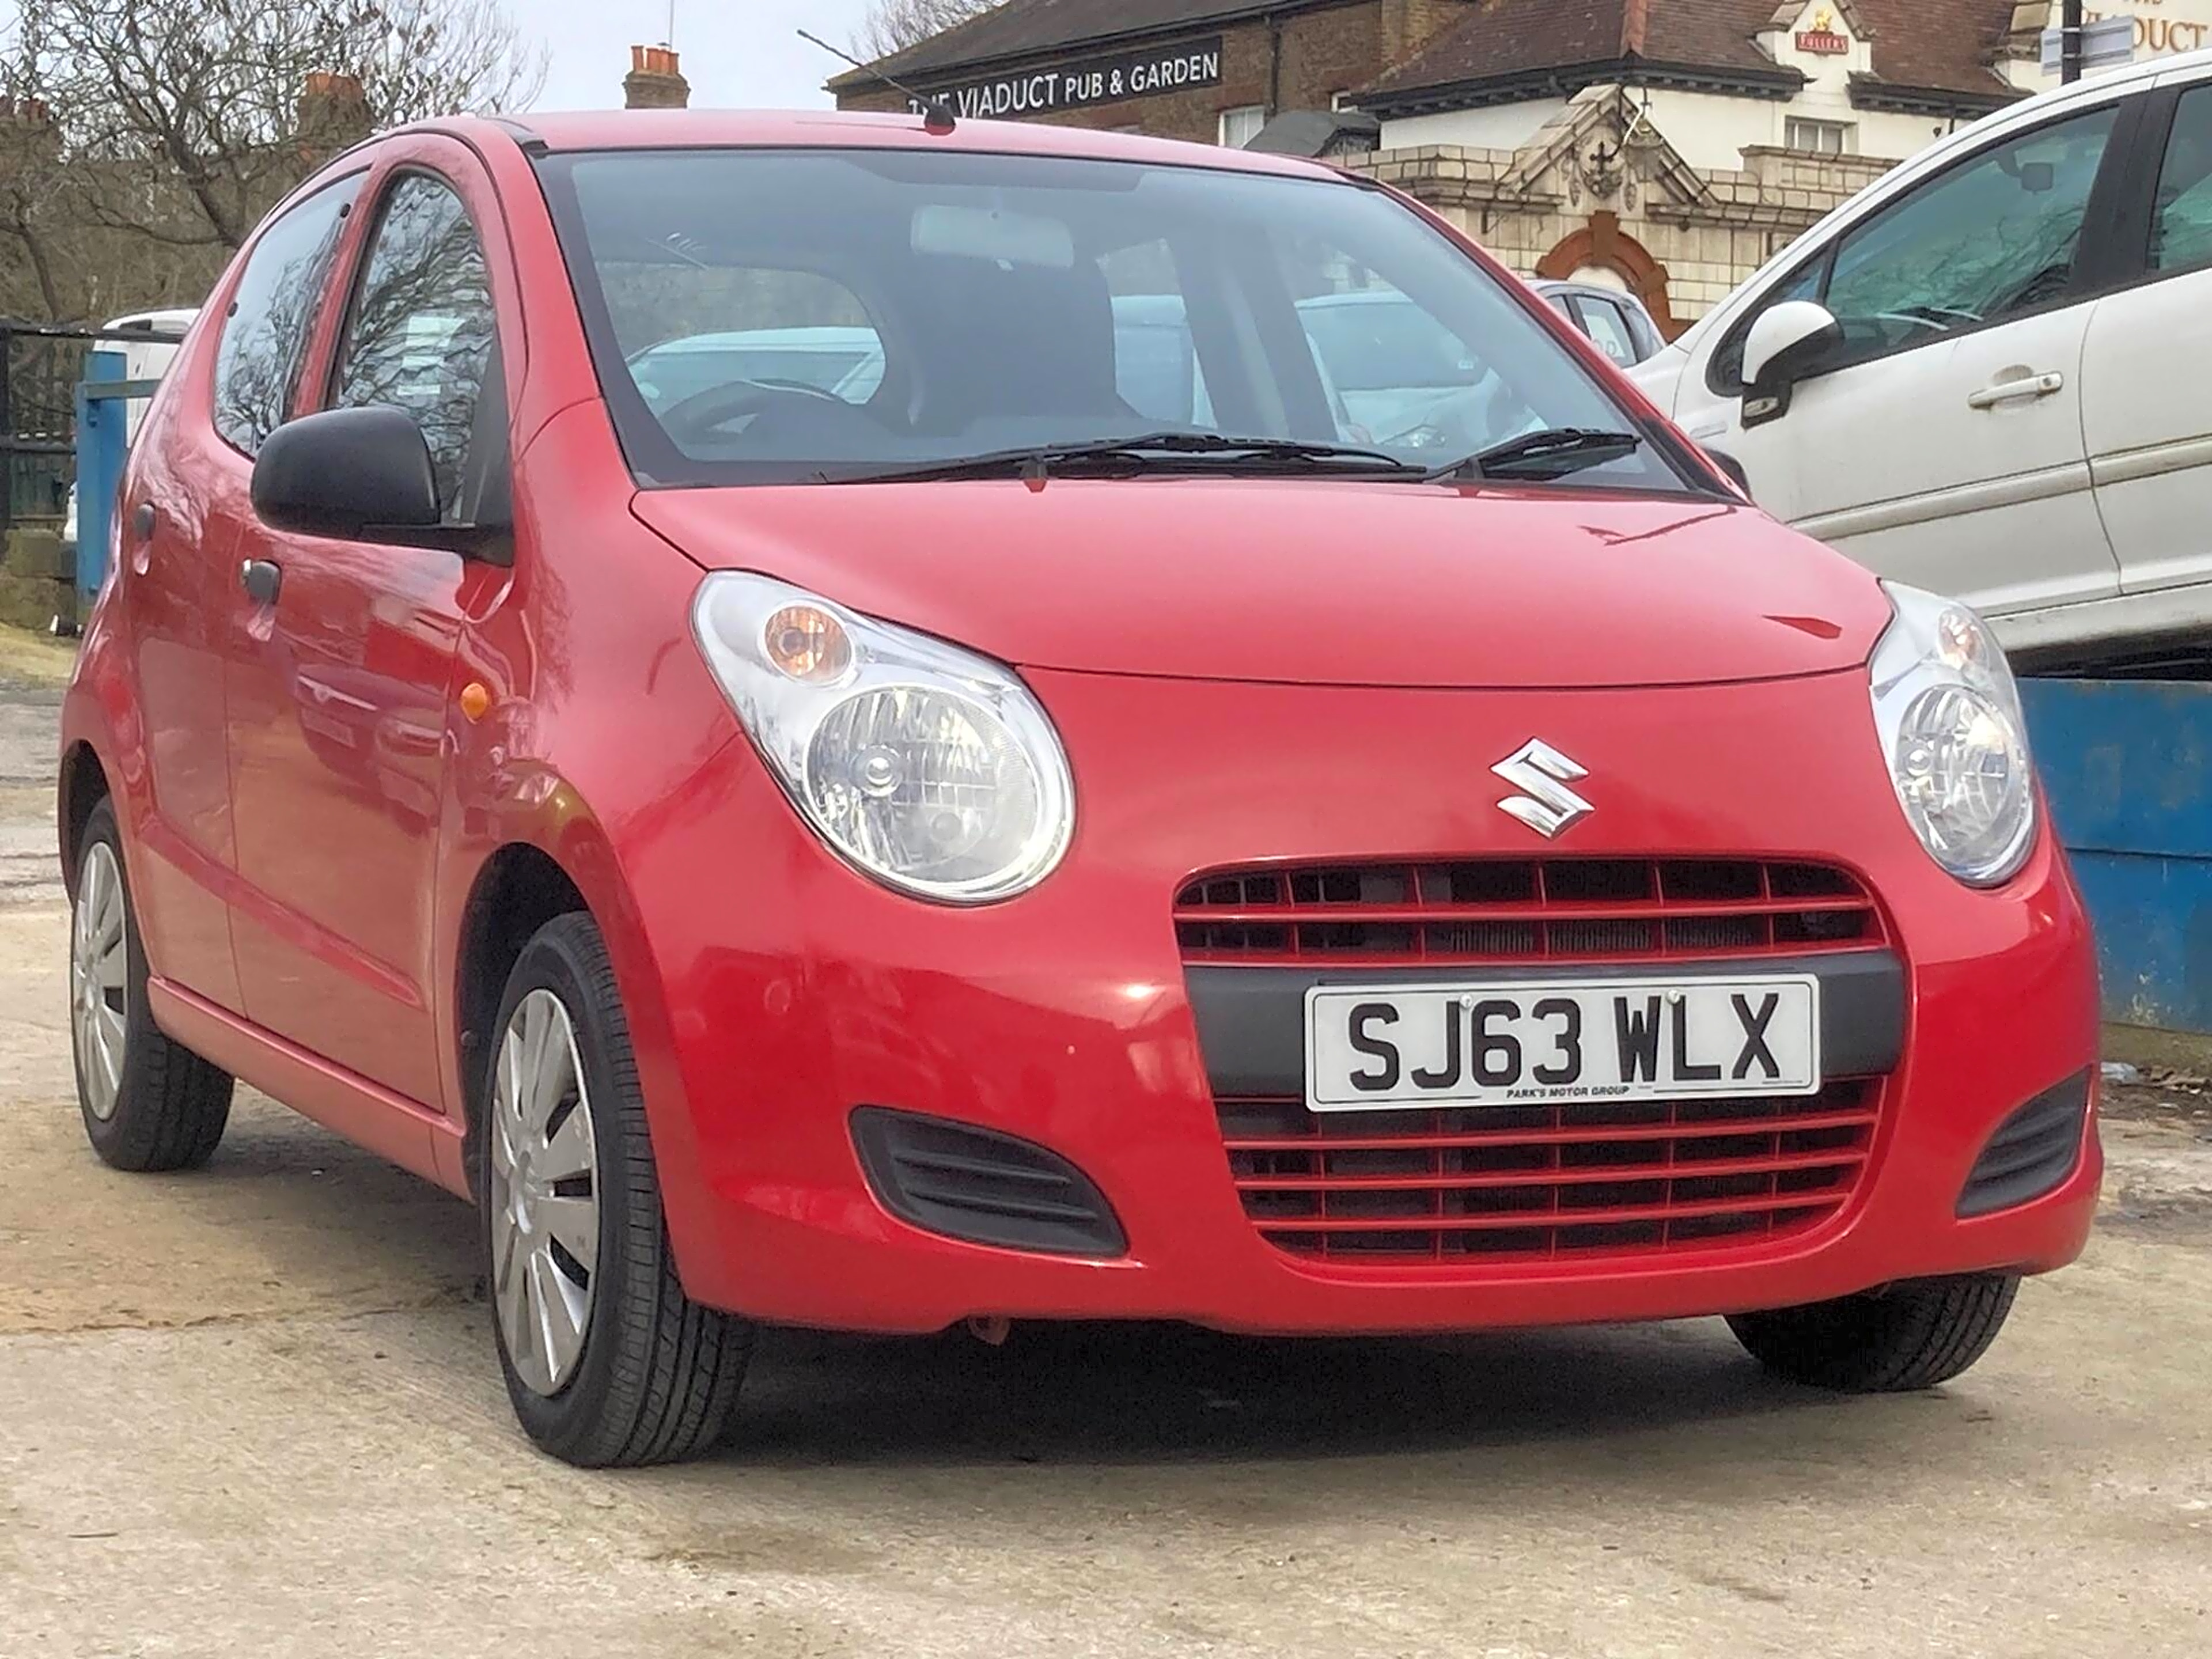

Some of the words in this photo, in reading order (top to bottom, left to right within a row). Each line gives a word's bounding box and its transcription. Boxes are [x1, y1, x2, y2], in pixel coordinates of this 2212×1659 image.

[957, 73, 1059, 119] VIADUCT
[1065, 73, 1103, 103] PUB
[1109, 69, 1123, 95] &
[1130, 52, 1218, 92] GARDEN
[1348, 999, 1582, 1091] SJ63
[1613, 993, 1780, 1083] WLX
[1506, 1088, 1546, 1099] PARK'S
[1548, 1086, 1589, 1097] MOTOR
[1591, 1085, 1630, 1096] GROUP
